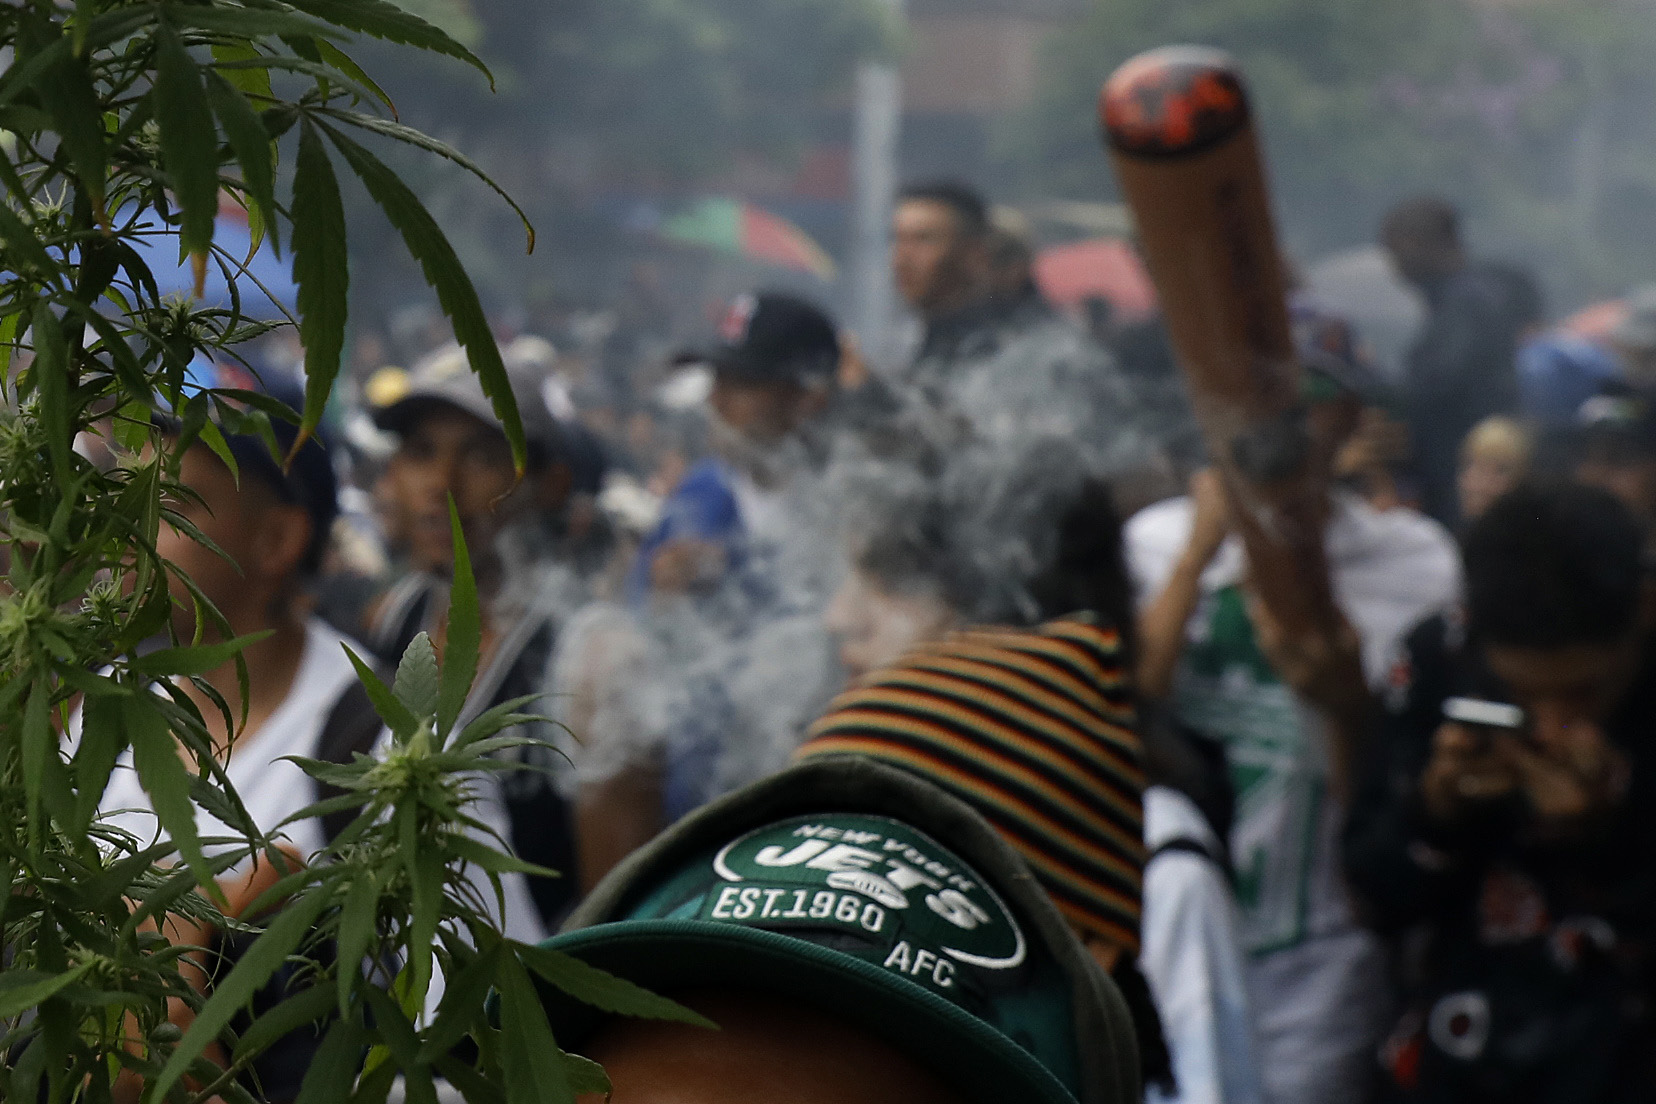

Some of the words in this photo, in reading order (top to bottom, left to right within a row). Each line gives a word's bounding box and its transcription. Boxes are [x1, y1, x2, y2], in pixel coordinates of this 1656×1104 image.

[754, 839, 992, 931] JETS
[793, 824, 882, 845] NEW
[882, 838, 977, 892] YORK
[711, 886, 886, 933] EST.1960
[883, 940, 956, 988] AFC
